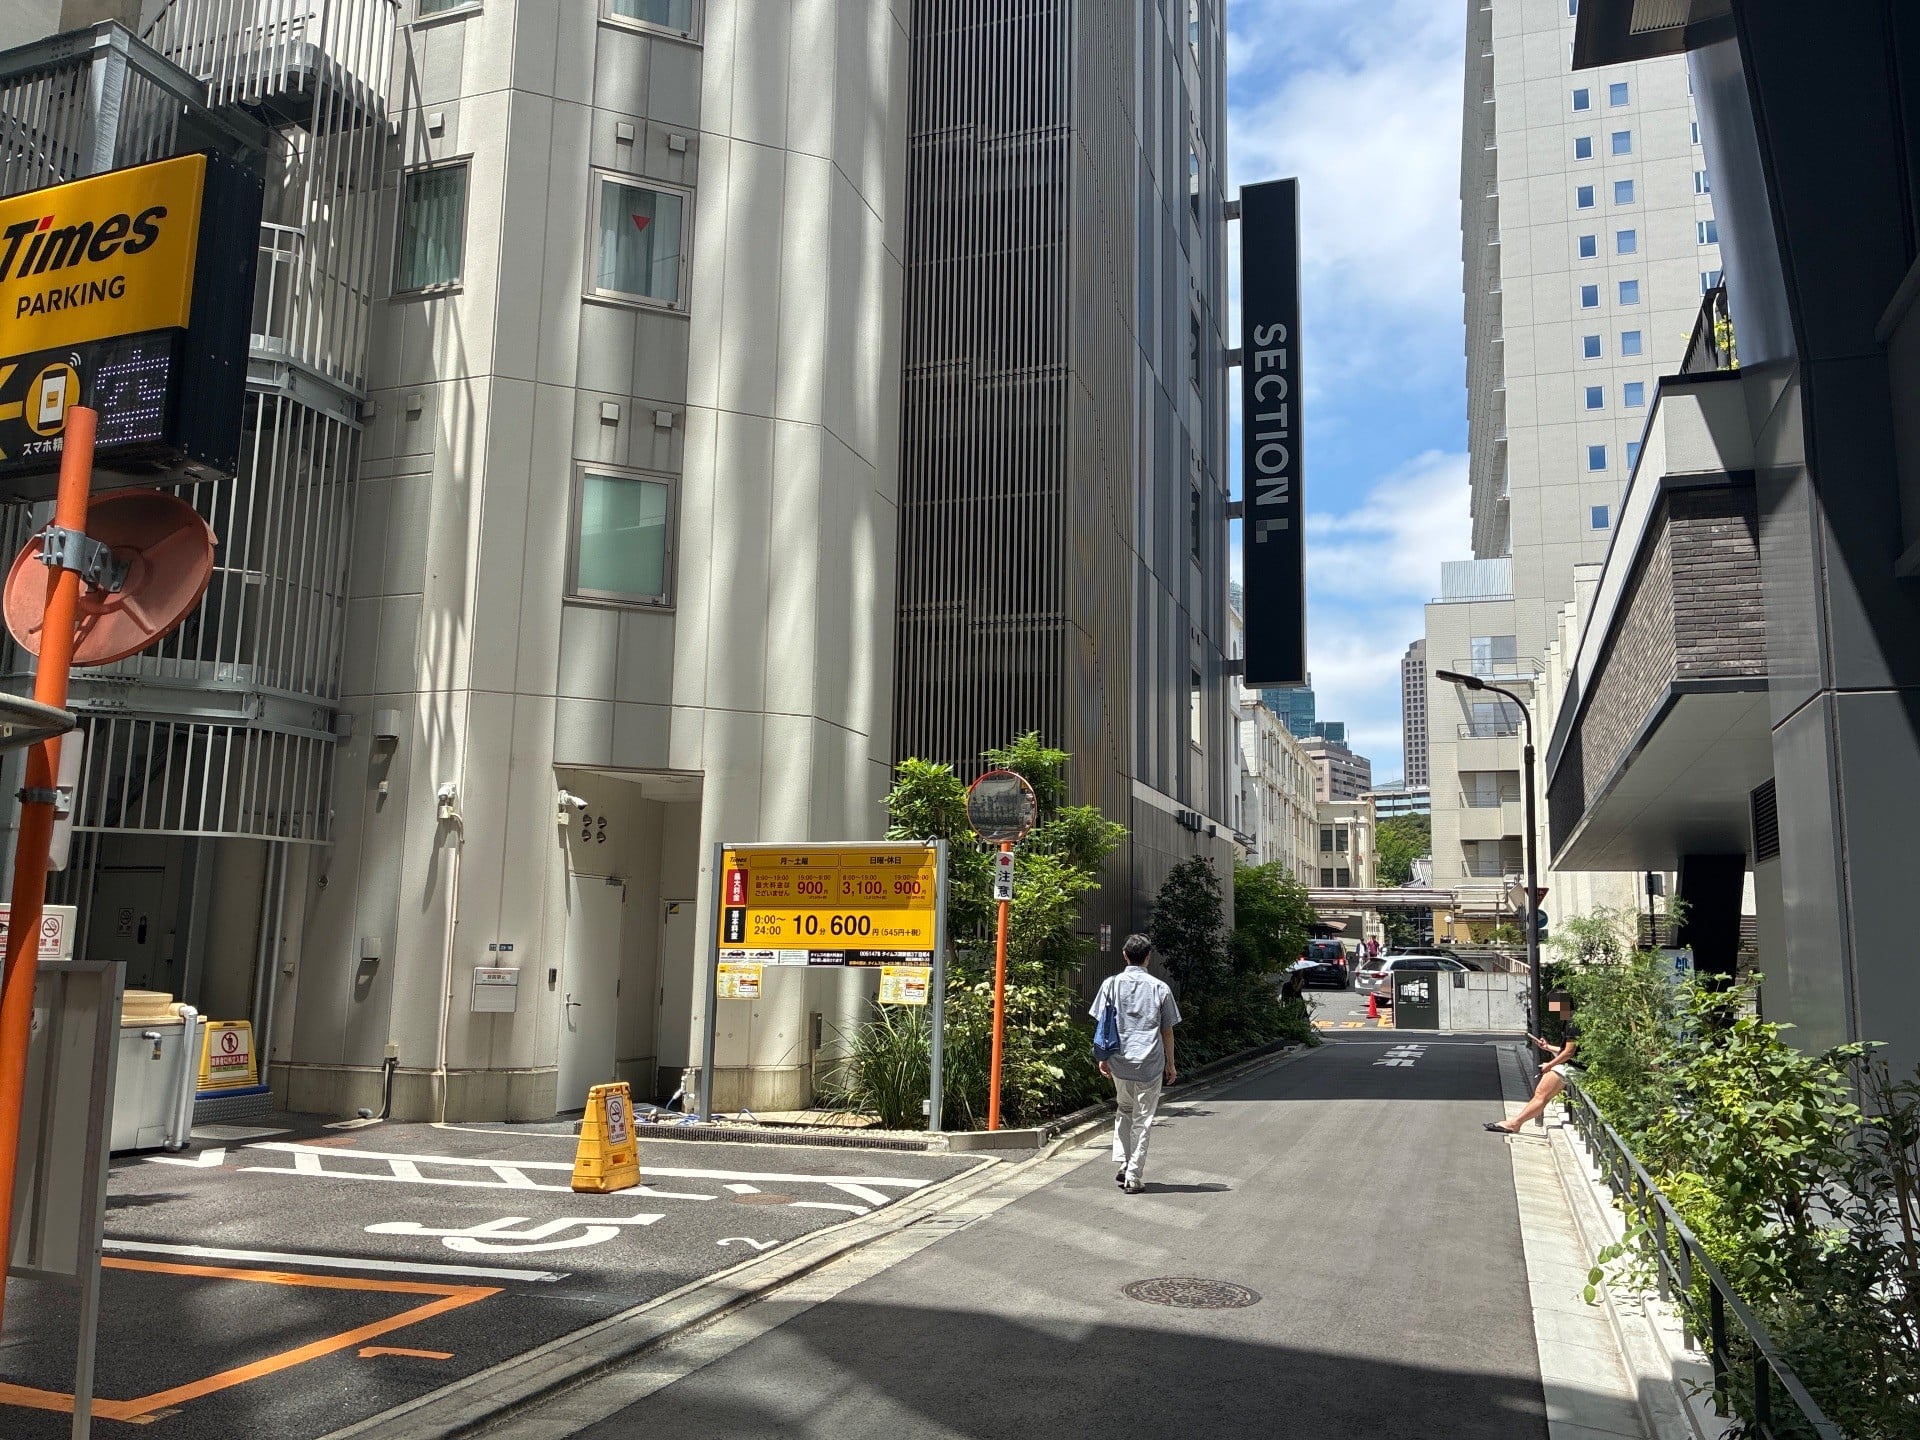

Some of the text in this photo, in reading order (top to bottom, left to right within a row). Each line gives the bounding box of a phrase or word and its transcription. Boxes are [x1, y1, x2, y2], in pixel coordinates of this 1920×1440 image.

[0, 206, 168, 283] Times
[16, 275, 126, 319] PARKING
[22, 437, 64, 457] スマホ精
[1253, 322, 1290, 544] SECTION L
[997, 870, 1012, 898] 注意
[754, 925, 782, 936] 24:00
[715, 1236, 781, 1251] 2
